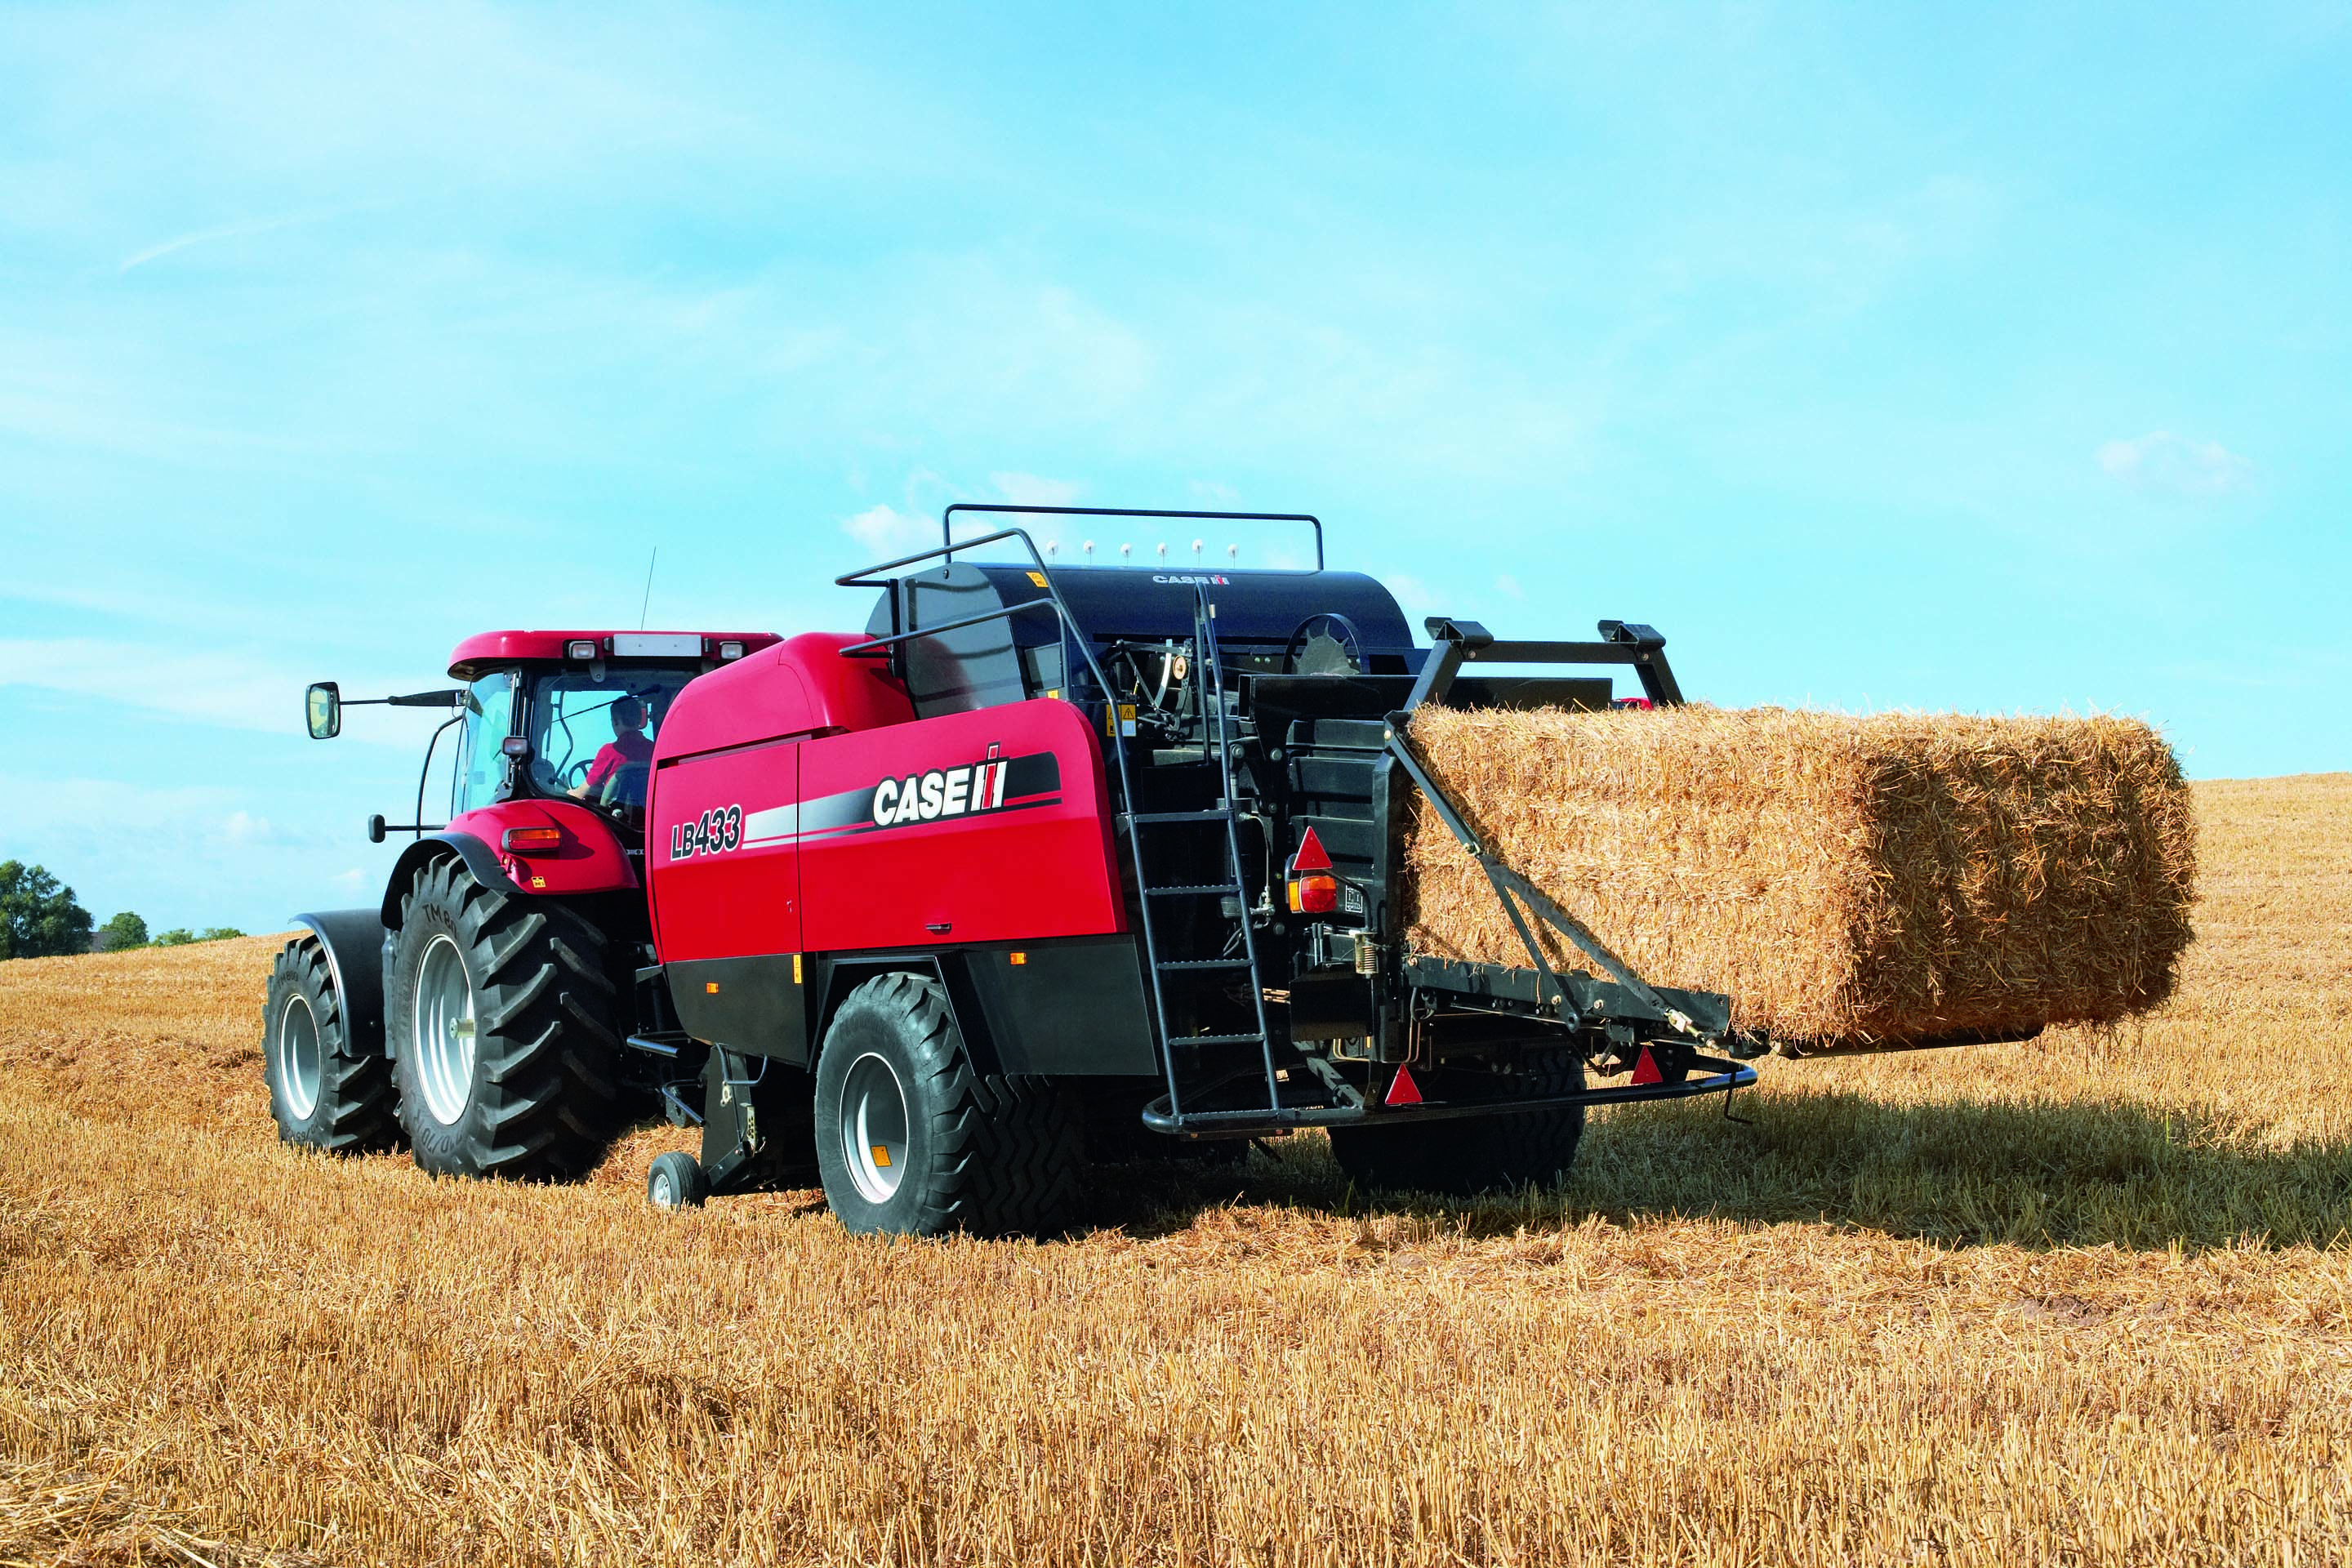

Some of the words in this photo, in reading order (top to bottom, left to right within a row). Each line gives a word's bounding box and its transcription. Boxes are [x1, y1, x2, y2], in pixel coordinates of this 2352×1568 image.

[1152, 575, 1209, 584] CASE
[873, 768, 971, 826] CASE
[671, 804, 742, 862] LB433
